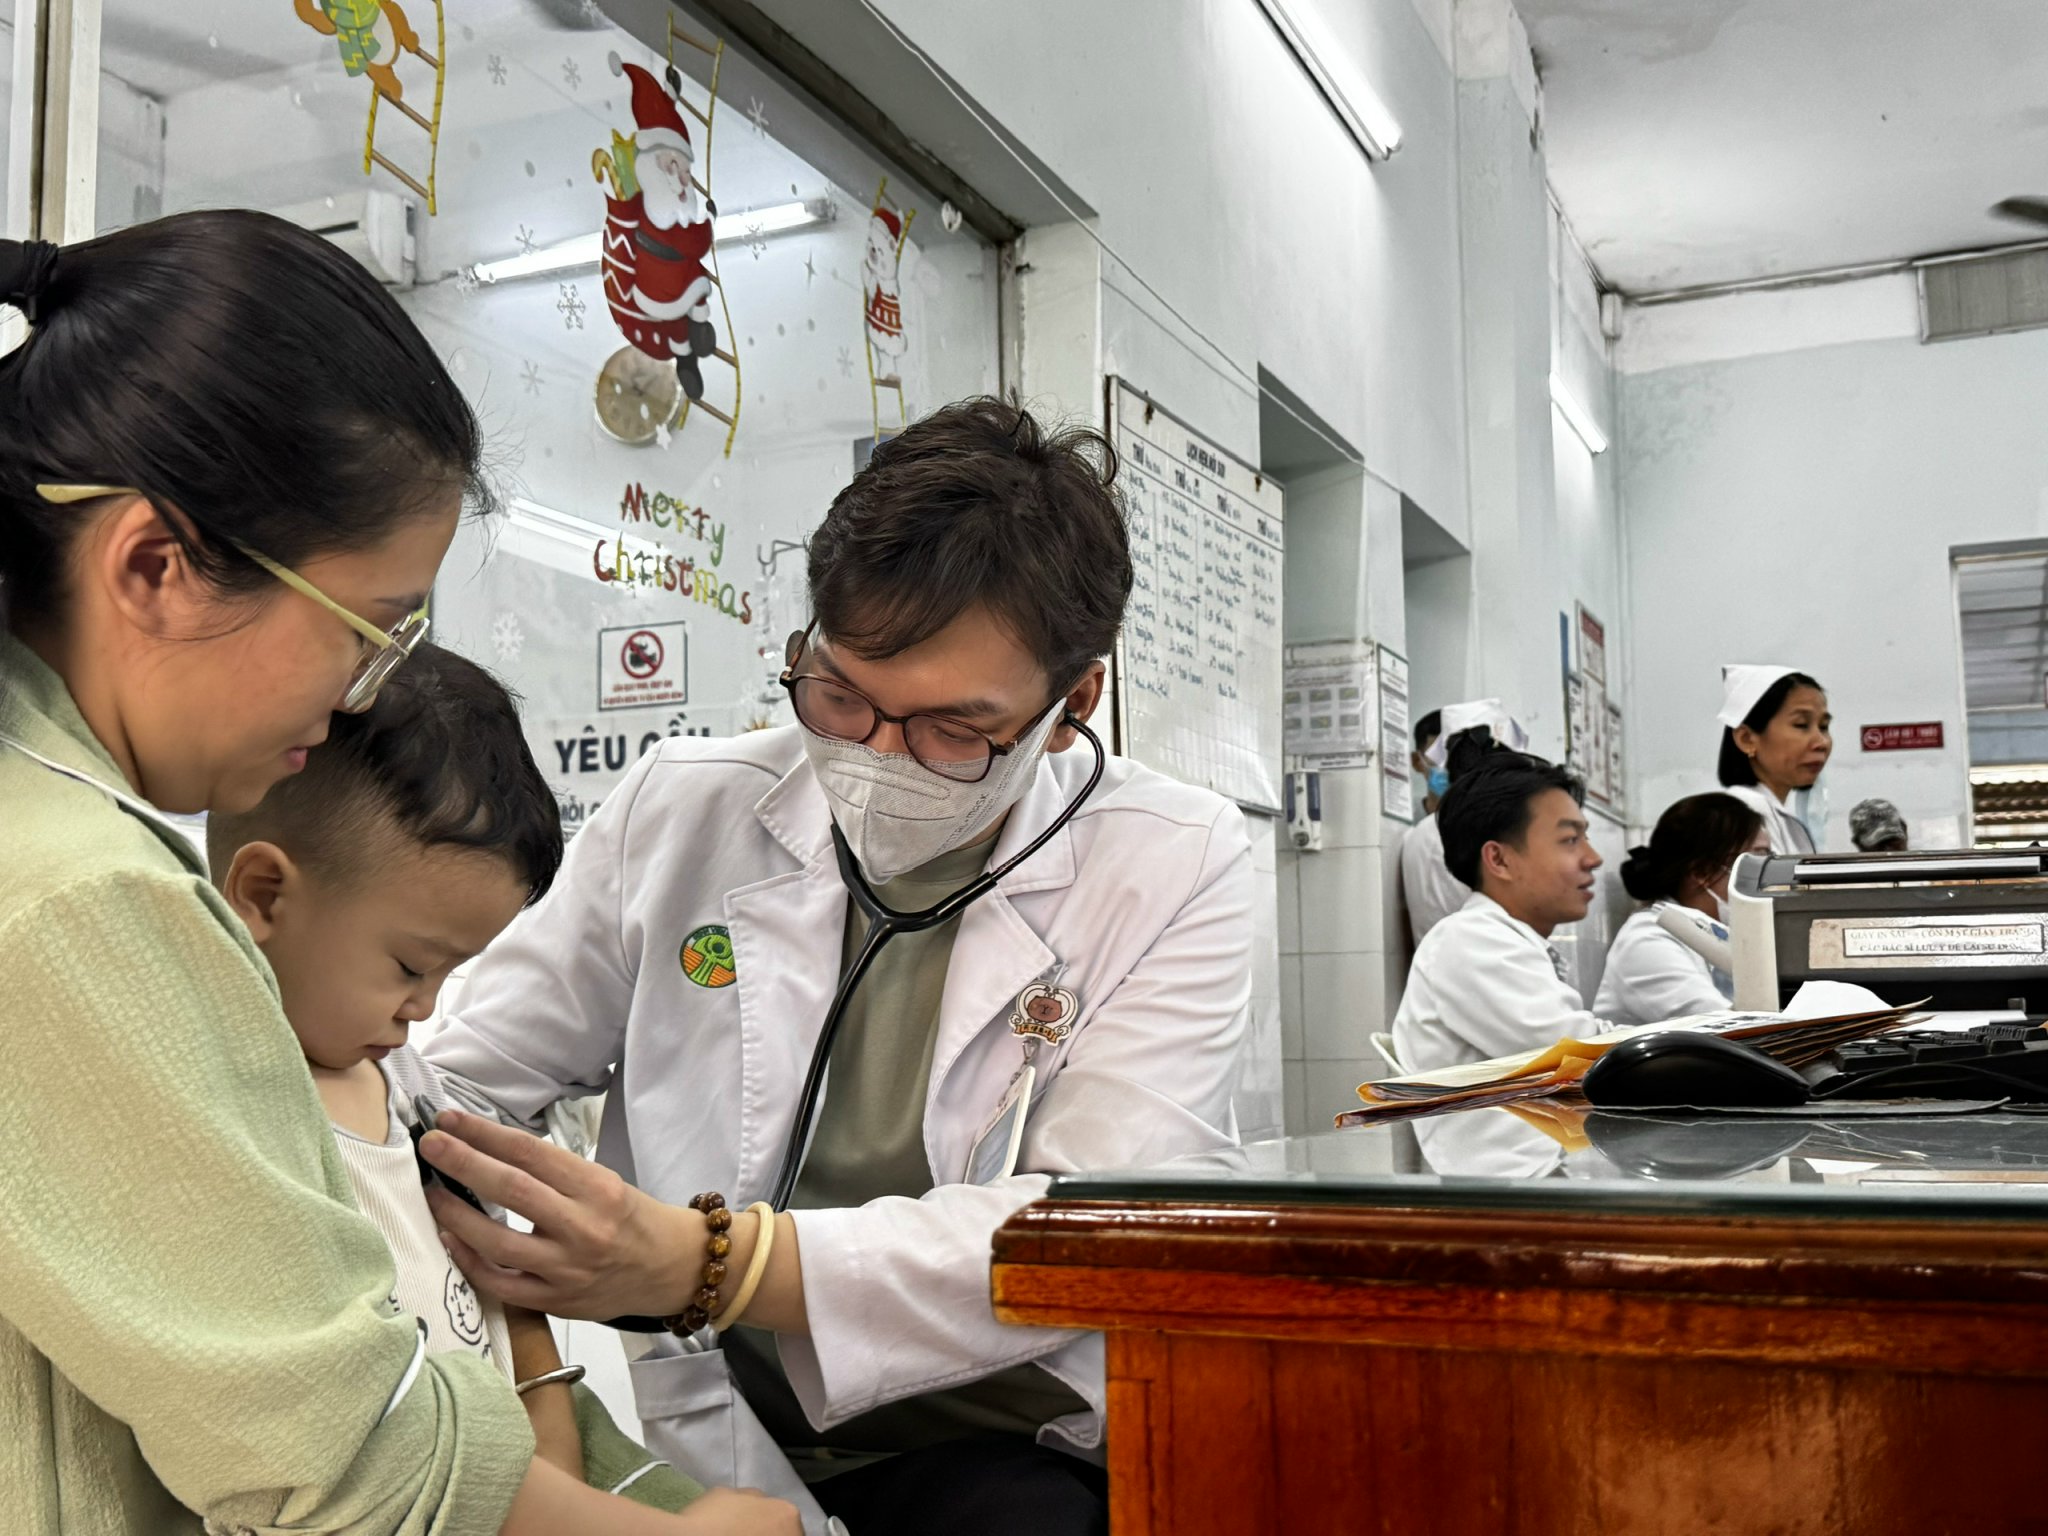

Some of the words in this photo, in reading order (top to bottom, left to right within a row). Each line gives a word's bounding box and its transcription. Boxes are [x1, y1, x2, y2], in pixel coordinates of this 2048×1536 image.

[620, 481, 725, 567] Merry
[594, 530, 751, 624] Christmas
[554, 724, 626, 774] YÊU
